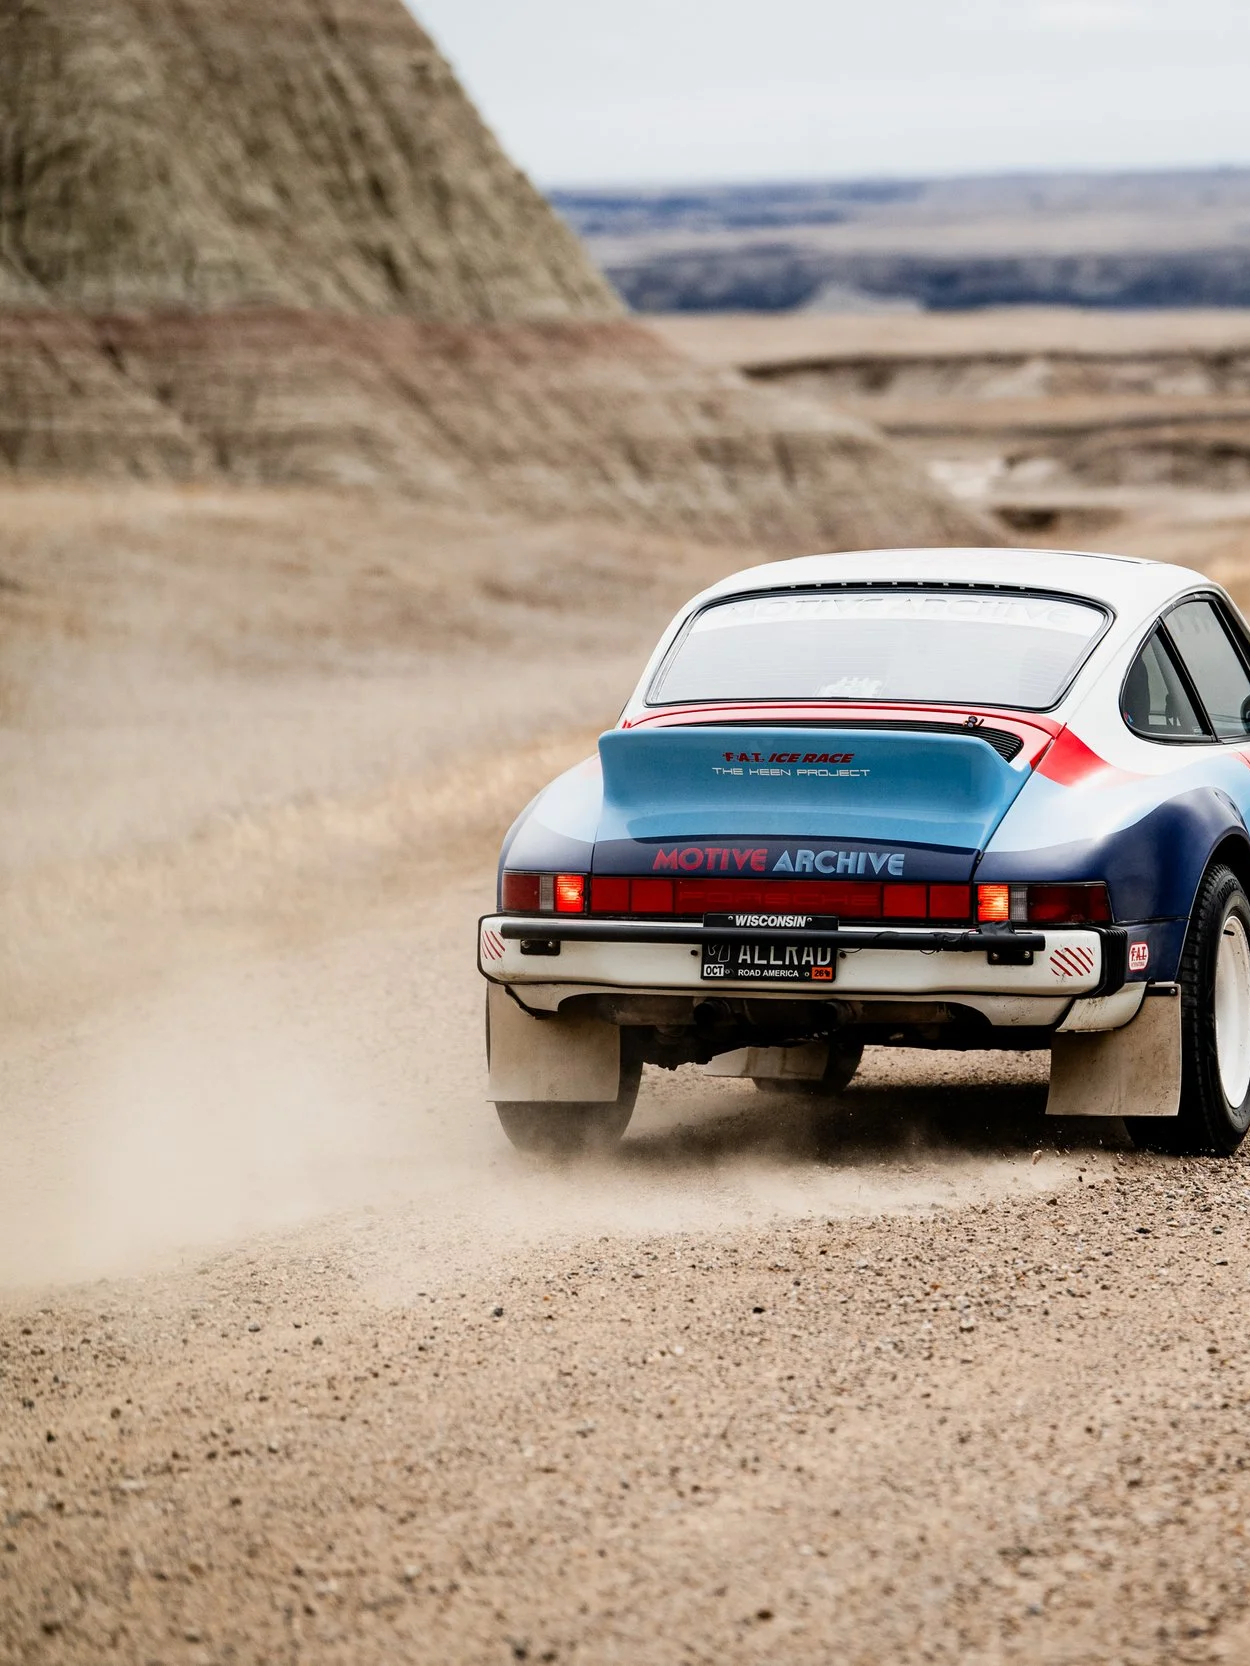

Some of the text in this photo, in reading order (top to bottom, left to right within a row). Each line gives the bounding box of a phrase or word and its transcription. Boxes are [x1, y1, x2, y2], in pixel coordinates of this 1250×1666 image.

[768, 752, 802, 763] ICE
[802, 753, 855, 764] RACE
[712, 767, 871, 777] THE KEEN PROJECT
[652, 847, 905, 876] MOTIVE ARCHIVE
[678, 891, 879, 906] PORSCHE
[735, 914, 807, 928] WISCONSIN
[738, 944, 832, 966] ALLRAD
[705, 965, 723, 976] OCT
[738, 968, 761, 977] ROAD
[762, 969, 799, 978] AMERICA
